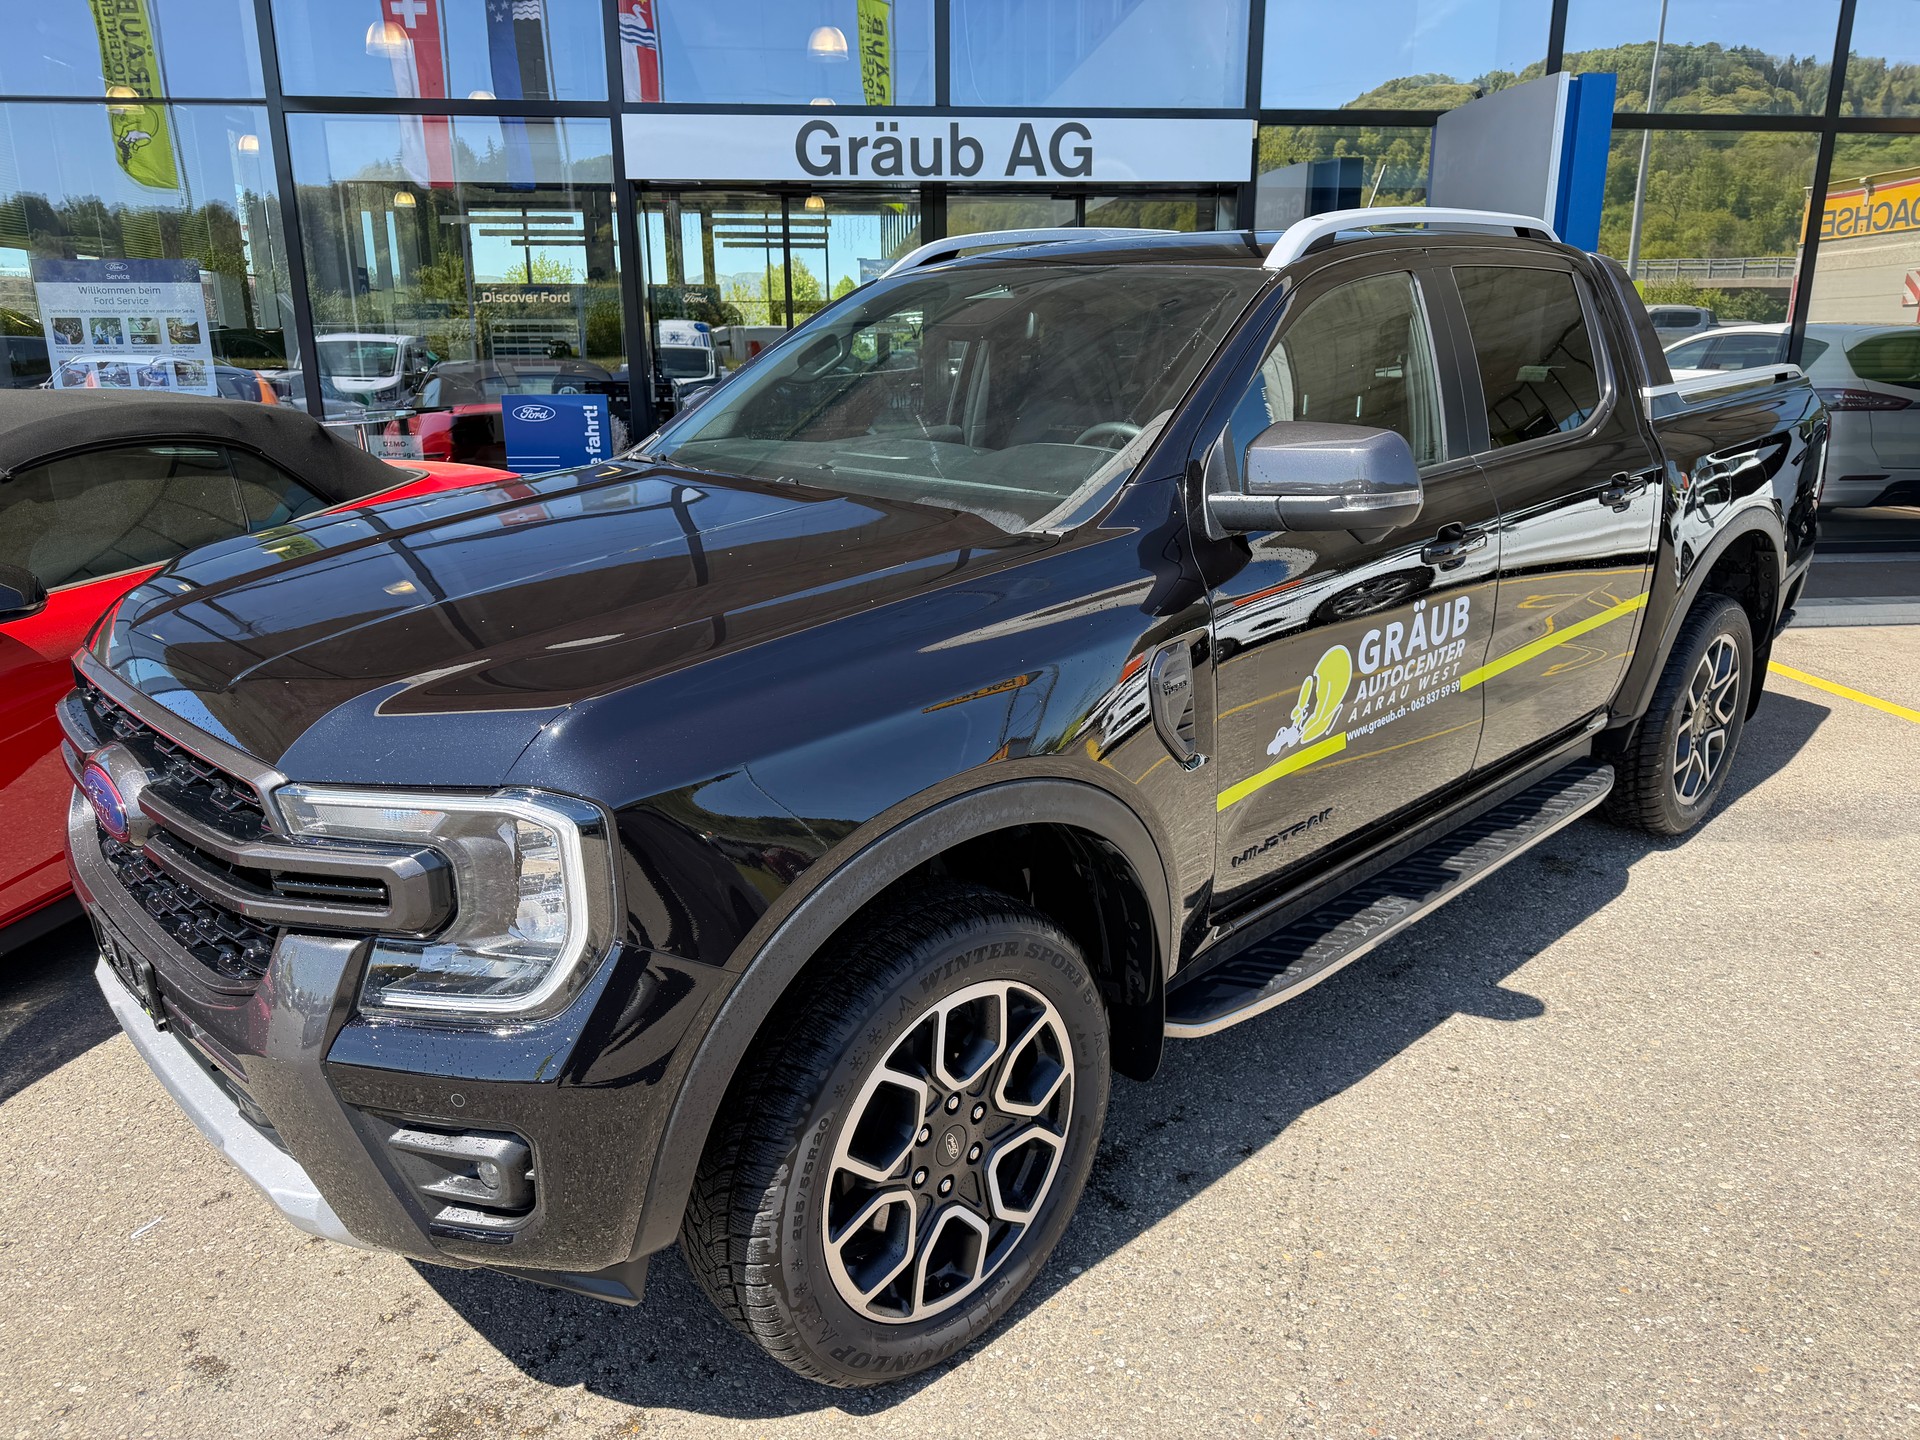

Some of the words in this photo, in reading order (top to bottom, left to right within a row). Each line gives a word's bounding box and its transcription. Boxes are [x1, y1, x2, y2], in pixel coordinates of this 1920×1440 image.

[795, 119, 984, 177] Gräub
[1004, 122, 1093, 177] AG
[77, 286, 136, 295] Willkommen
[138, 286, 161, 295] beim
[94, 297, 115, 305] Ford
[116, 297, 149, 305] Service
[482, 291, 539, 303] Discover
[541, 291, 571, 303] Ford
[682, 292, 708, 303] Ford
[519, 405, 548, 420] Ford
[584, 405, 601, 456] fahrt!
[1358, 596, 1470, 674] GRÄUB
[1348, 684, 1410, 723] AARAU
[1418, 662, 1460, 691] WEST
[1354, 639, 1466, 704] AUTOCENTER
[1346, 704, 1406, 742] www.graeub.ch
[1411, 696, 1425, 711] 062
[1426, 689, 1440, 706] 837
[1441, 684, 1451, 698] 59
[1451, 679, 1460, 693] 59
[919, 941, 1019, 994] WINTER
[1024, 942, 1086, 989] SPORT
[792, 1116, 831, 1243] 255/55R20
[828, 1336, 959, 1373] DUNLOP
